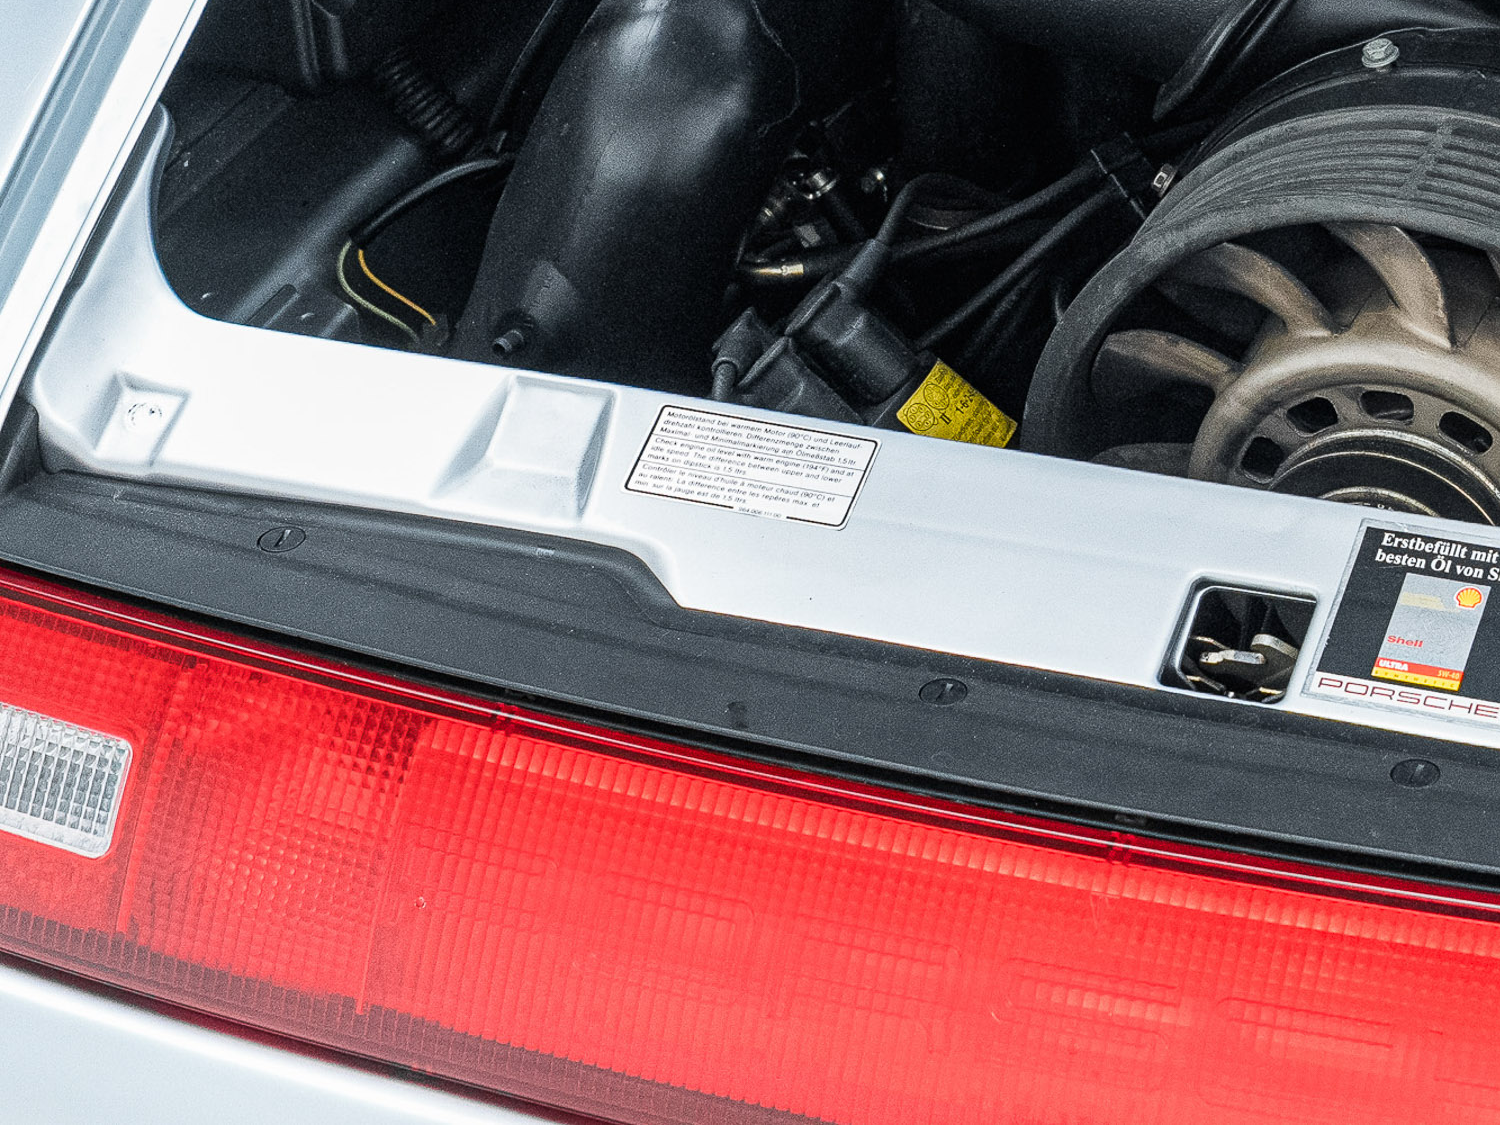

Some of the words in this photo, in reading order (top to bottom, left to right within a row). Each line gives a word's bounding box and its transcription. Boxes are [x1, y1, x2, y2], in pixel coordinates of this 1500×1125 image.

[654, 437, 677, 446] Check
[679, 442, 705, 452] engine
[717, 448, 735, 456] level
[735, 451, 751, 459] with
[774, 458, 801, 468] engine
[830, 467, 846, 475] and
[707, 455, 746, 466] difference
[747, 461, 780, 472] between
[780, 468, 803, 477] upper
[804, 471, 820, 479] and
[820, 474, 842, 483] lower
[1380, 532, 1468, 558] Erstbefüllt
[1469, 546, 1500, 564] mit
[1374, 548, 1428, 569] besten
[1429, 554, 1453, 573] Öl
[1454, 563, 1484, 578] von
[1386, 635, 1424, 647] Shell
[1377, 659, 1409, 671] ULTRA
[1436, 669, 1460, 680] 5W-40
[1317, 676, 1500, 718] PORSCHE
